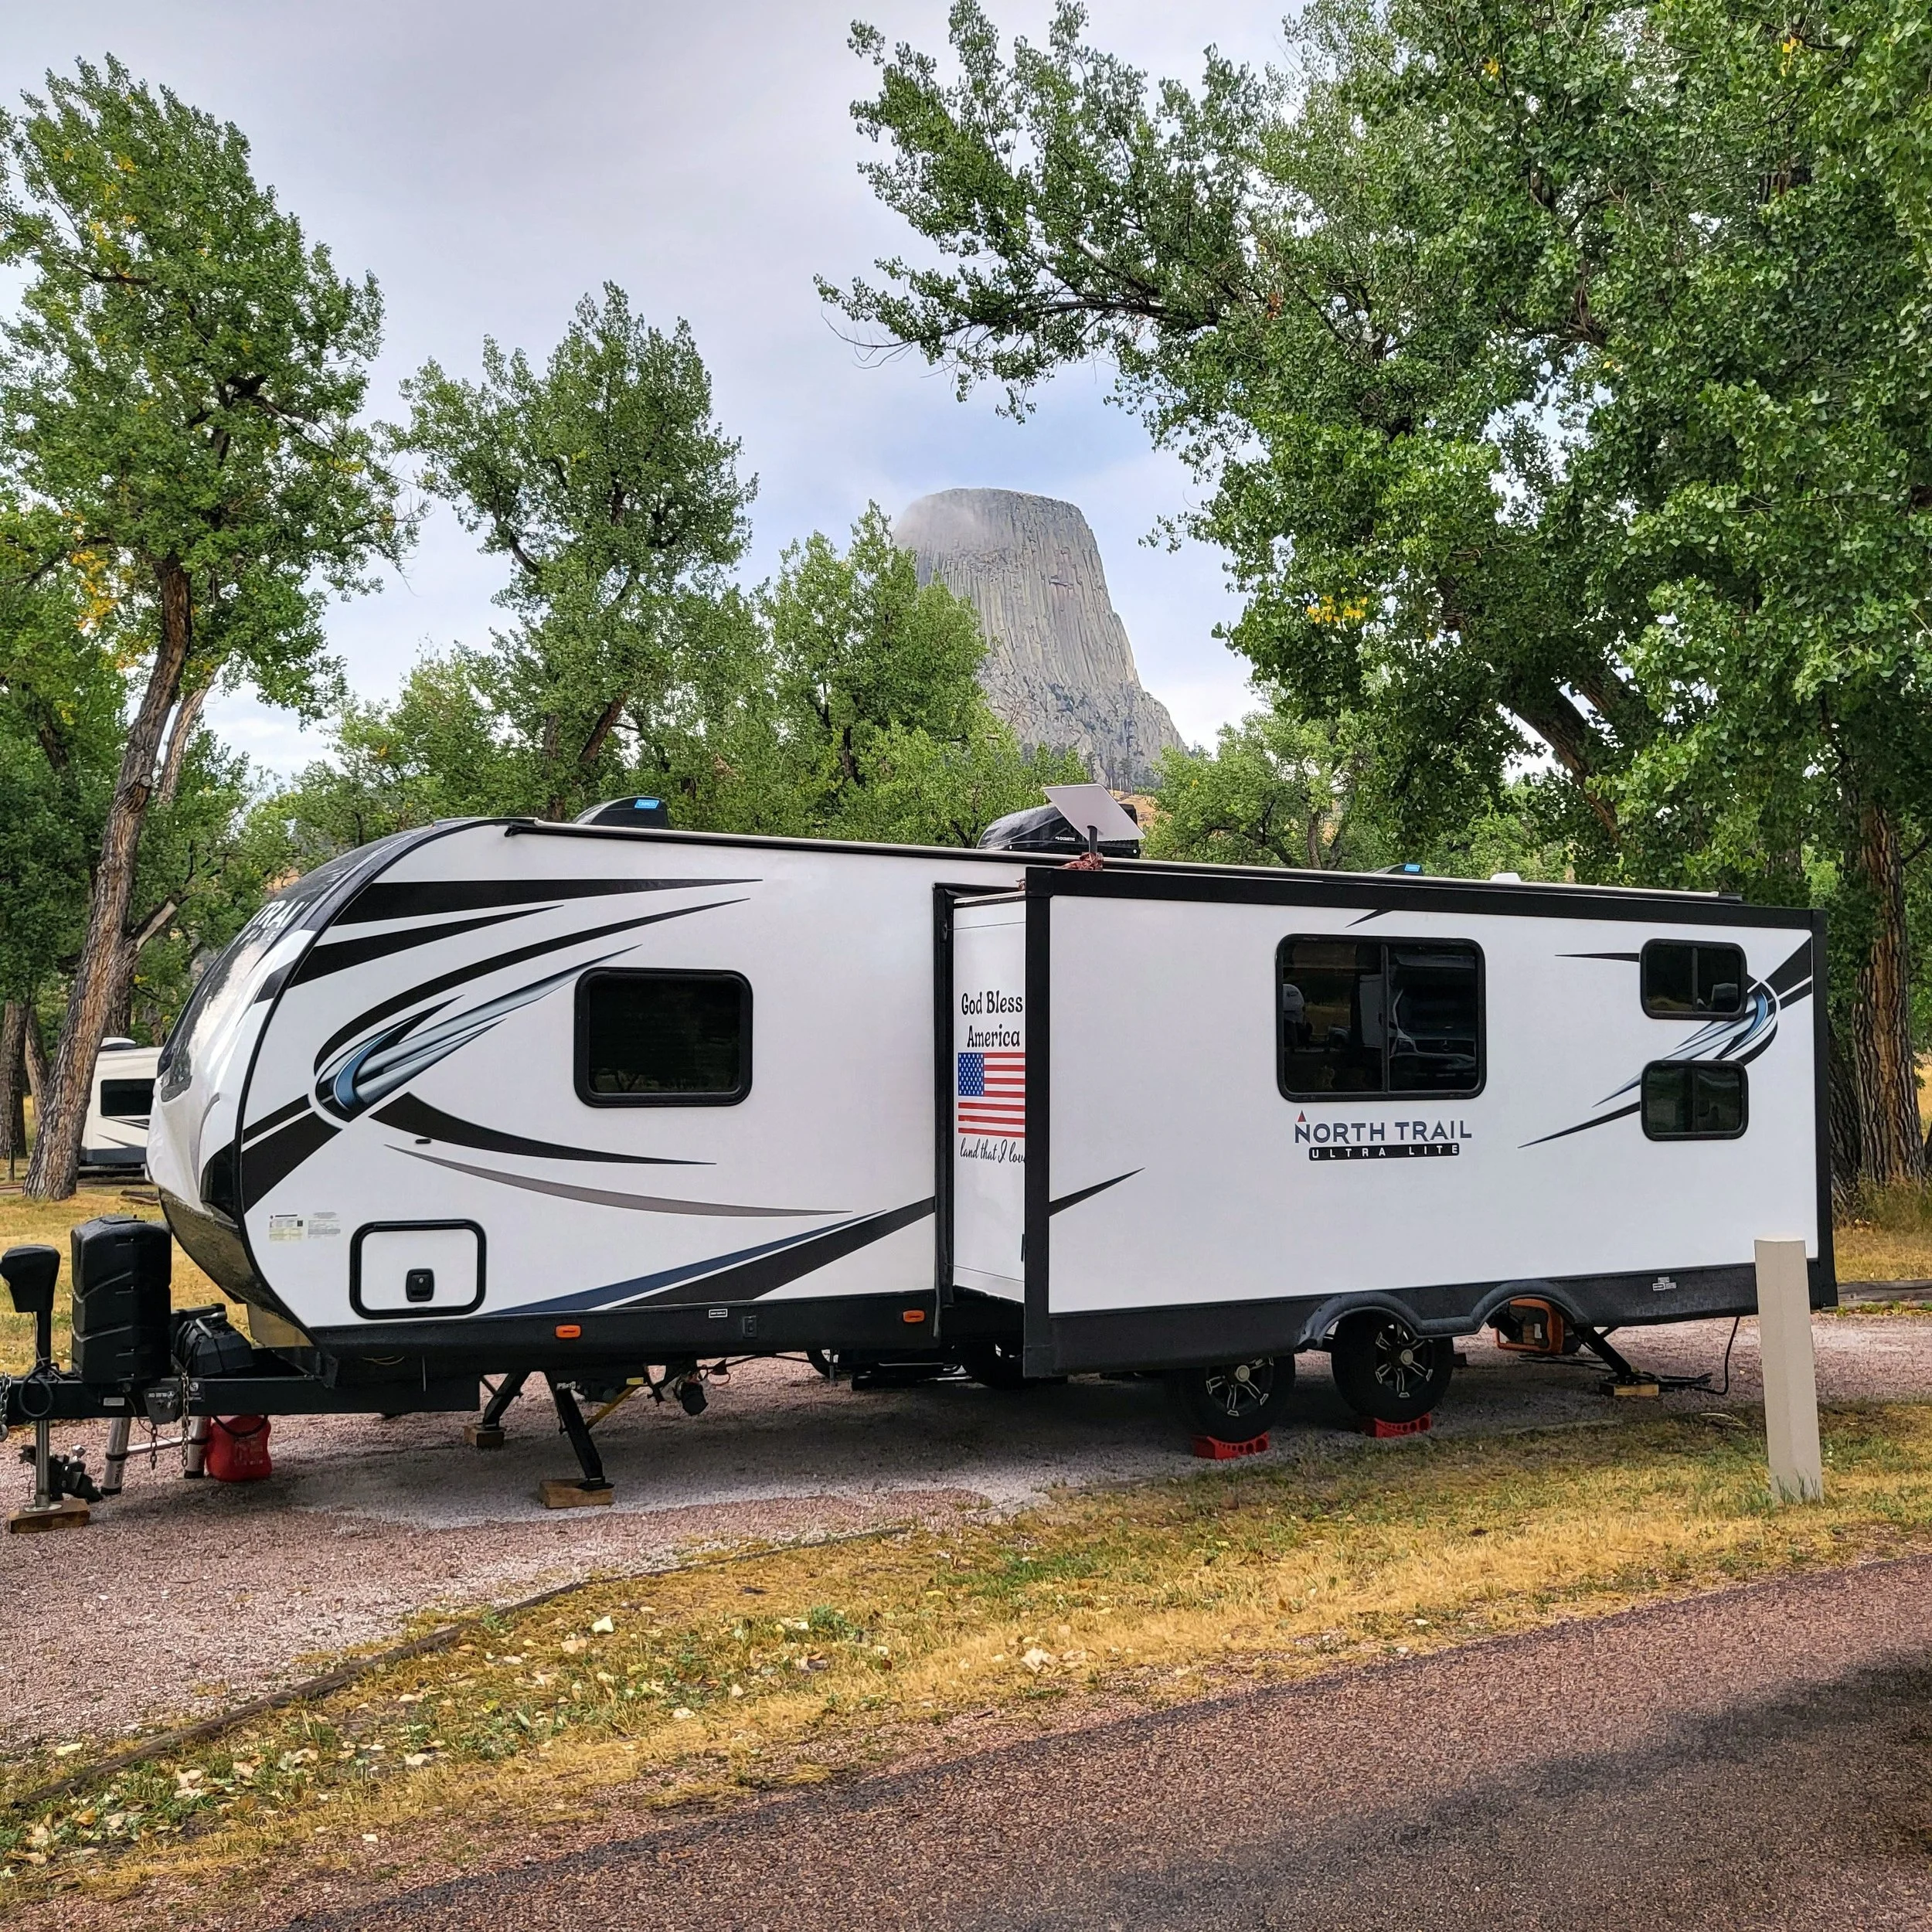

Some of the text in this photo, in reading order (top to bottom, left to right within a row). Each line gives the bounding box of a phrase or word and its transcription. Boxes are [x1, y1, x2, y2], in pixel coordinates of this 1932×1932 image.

[961, 990, 1023, 1015] God Bless
[967, 1023, 1020, 1047] America
[1294, 1121, 1472, 1144] NORTH TRAIL
[960, 1137, 981, 1158] land
[981, 1138, 998, 1161] that
[998, 1138, 1008, 1163] I
[1312, 1145, 1458, 1158] ULTRA LITE
